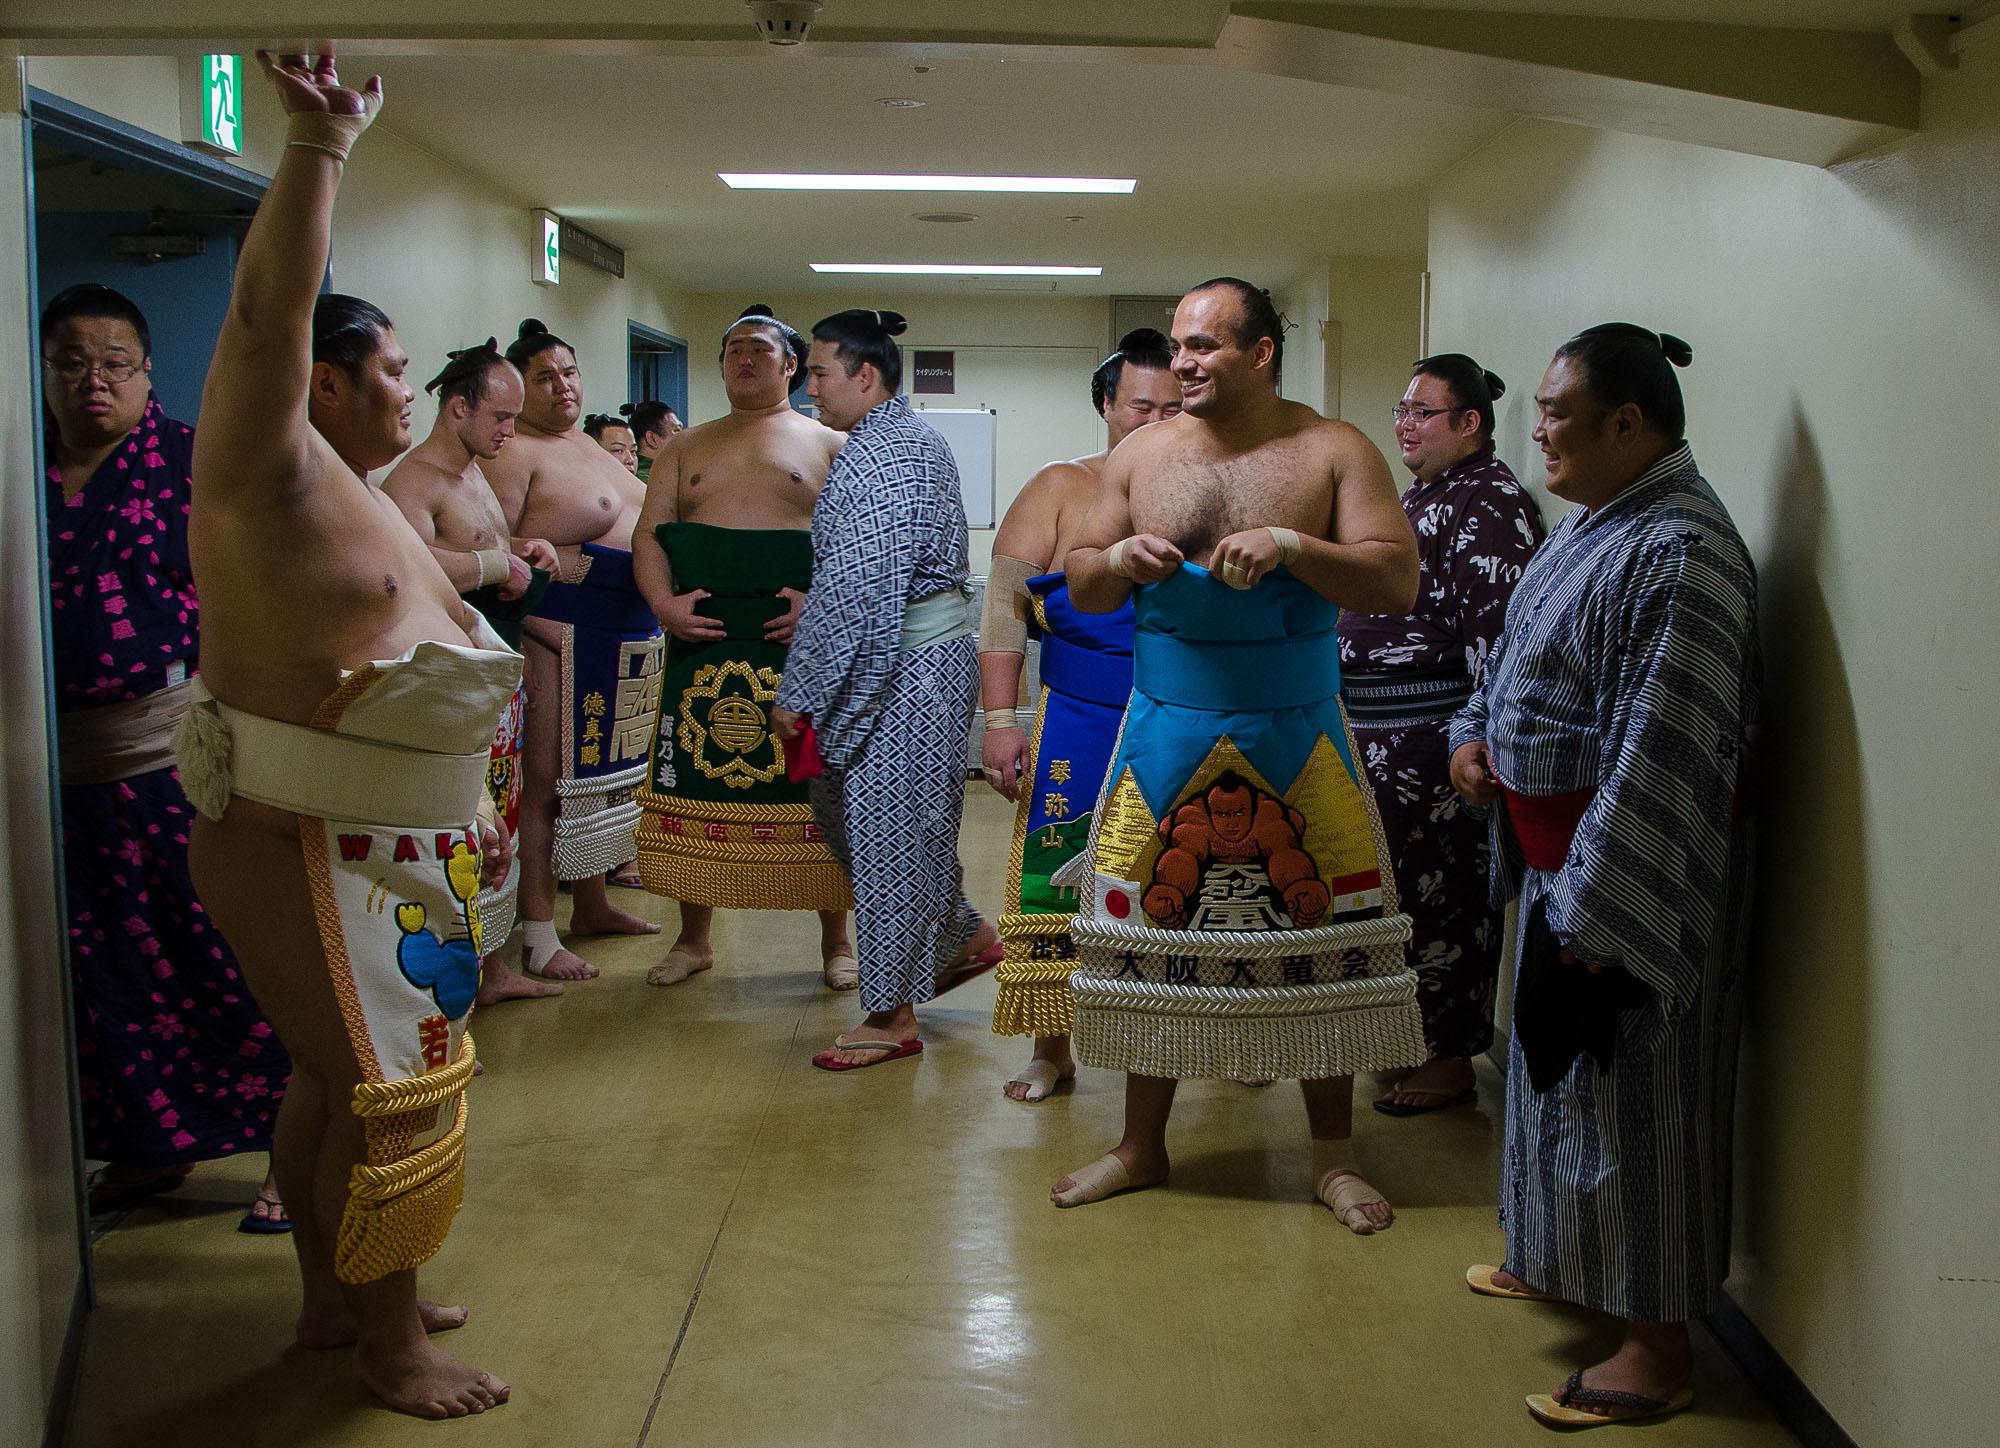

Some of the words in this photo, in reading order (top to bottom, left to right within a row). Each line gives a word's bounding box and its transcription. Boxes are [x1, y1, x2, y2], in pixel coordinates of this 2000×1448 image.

[581, 691, 607, 767] 徳真鵬
[1041, 759, 1072, 849] 琴弥山
[1187, 863, 1294, 931] 大砂嵐
